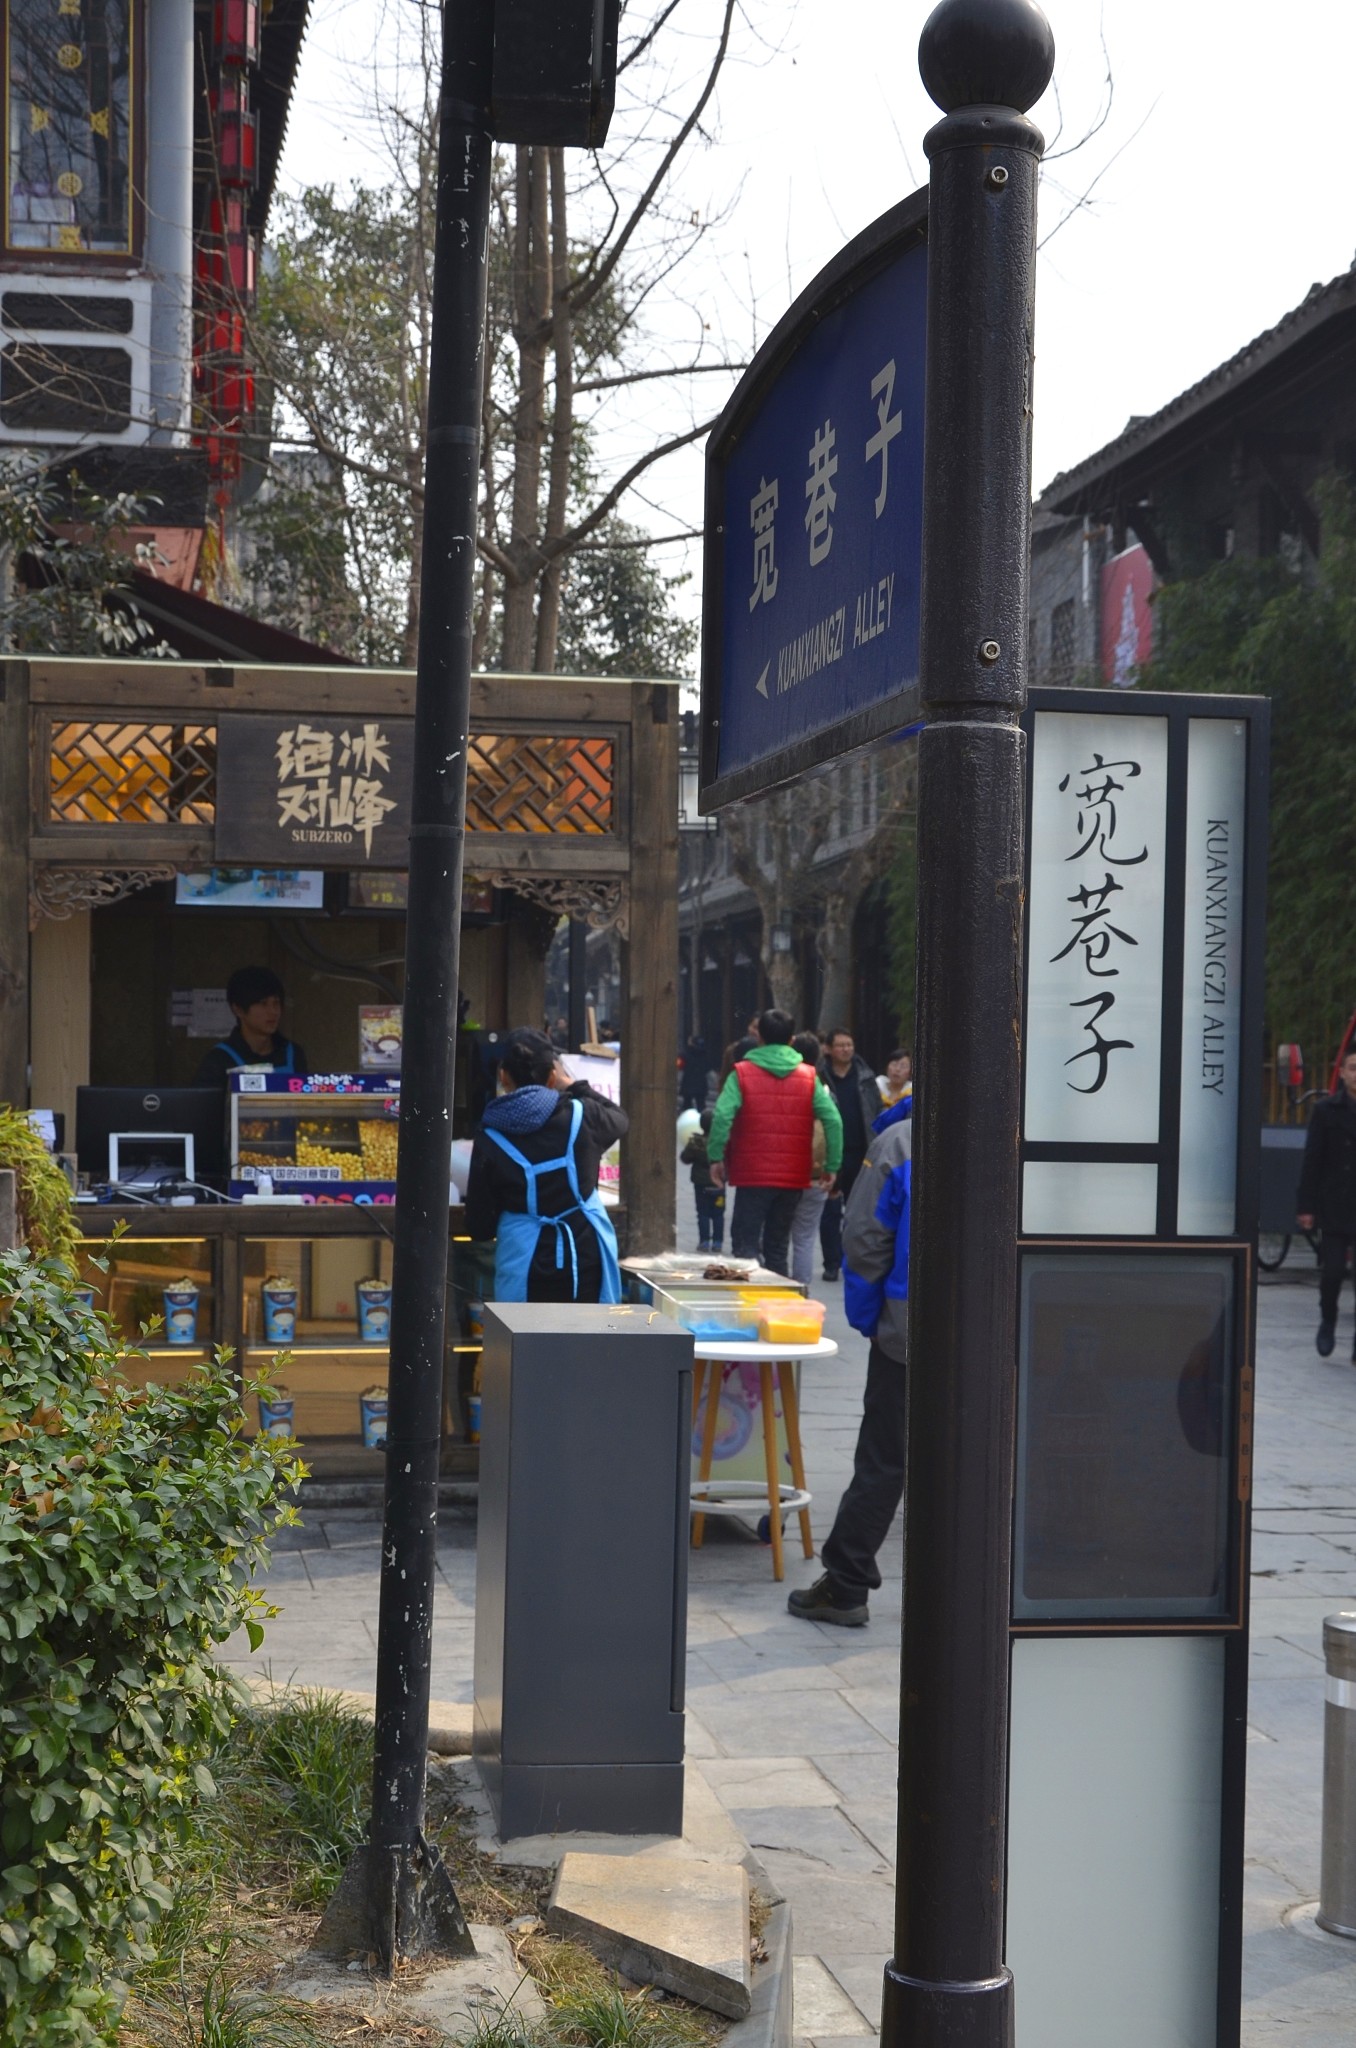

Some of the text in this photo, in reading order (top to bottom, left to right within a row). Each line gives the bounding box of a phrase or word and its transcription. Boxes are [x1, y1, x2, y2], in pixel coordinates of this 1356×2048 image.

[749, 357, 902, 614] 宽巷子
[777, 572, 895, 695] KUANXIANGZI ALLEY
[291, 829, 353, 844] SUBZERO
[1049, 752, 1149, 1095] 宽巷子
[1201, 818, 1229, 1096] KUANXIANGZI ALLEY
